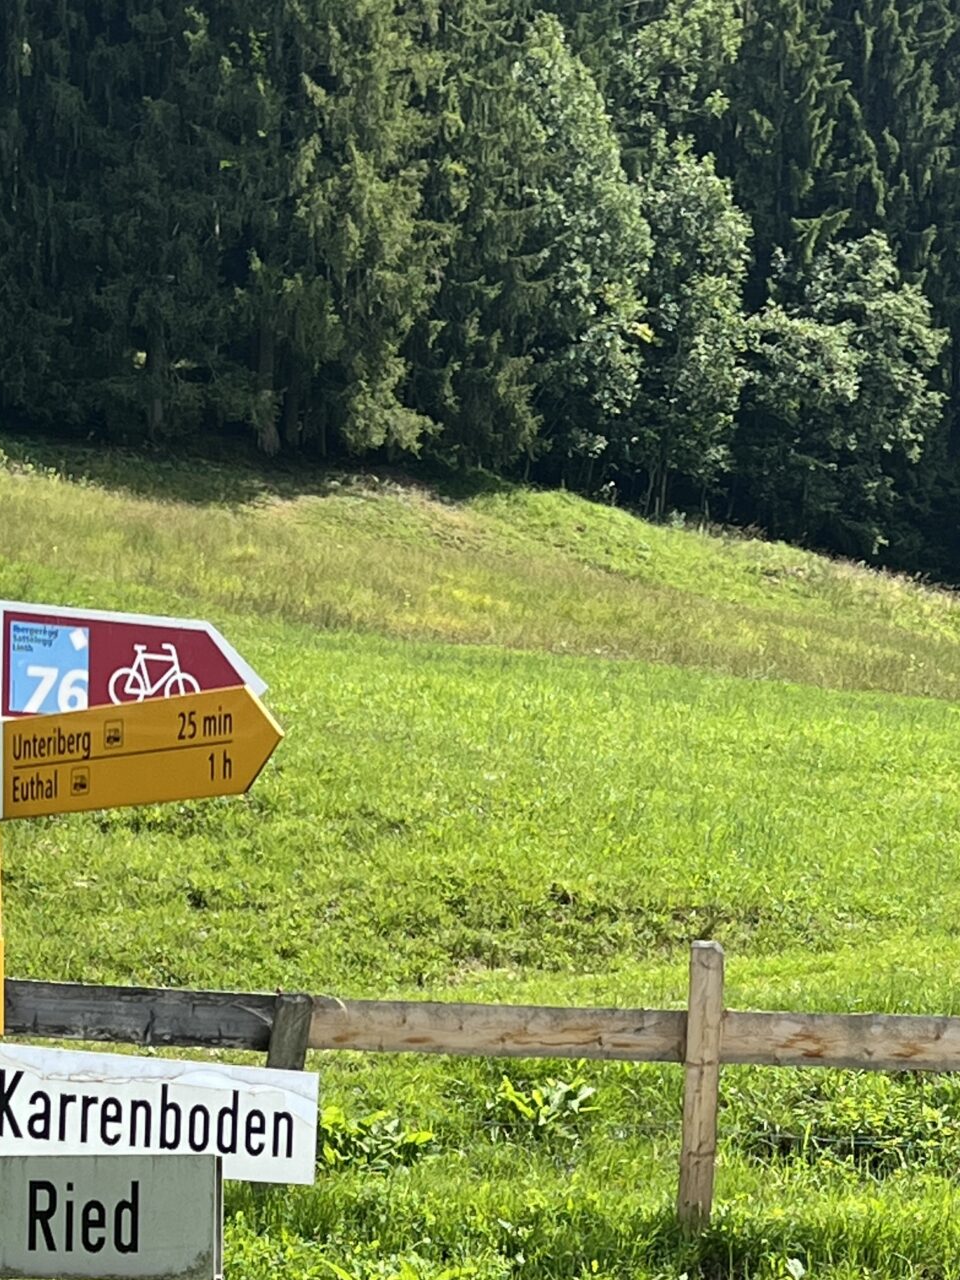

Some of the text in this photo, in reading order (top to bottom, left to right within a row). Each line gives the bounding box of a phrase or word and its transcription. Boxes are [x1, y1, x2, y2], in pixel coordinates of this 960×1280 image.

[22, 665, 89, 713] 76
[13, 706, 233, 761] Unteriberg 25 min
[13, 769, 58, 803] Euthal
[208, 752, 215, 781] 1
[223, 750, 232, 779] h
[27, 1180, 139, 1253] Ried
